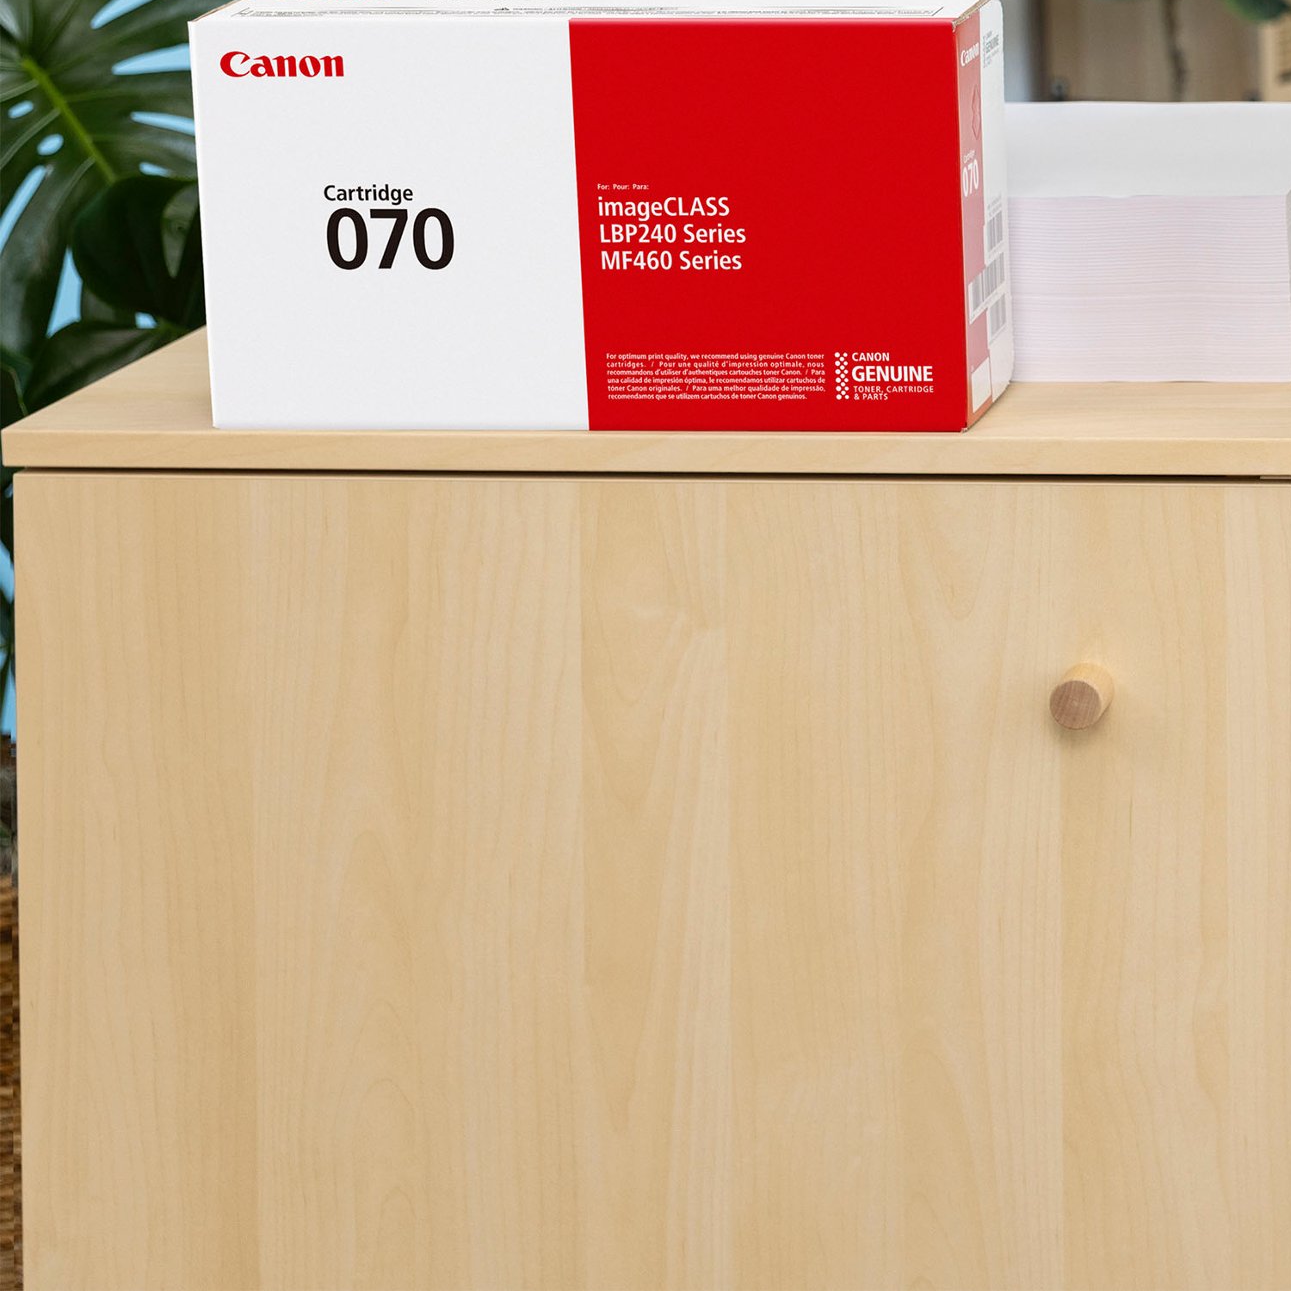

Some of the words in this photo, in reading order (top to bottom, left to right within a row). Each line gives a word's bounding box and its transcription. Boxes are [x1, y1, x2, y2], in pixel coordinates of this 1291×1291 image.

[220, 51, 344, 77] Canon
[960, 42, 980, 66] Canon
[962, 159, 979, 197] 070
[324, 184, 413, 206] Cartridge
[598, 196, 729, 221] imageCLASS
[327, 208, 454, 270] 070
[600, 224, 676, 243] LBP240
[684, 223, 746, 243] Series
[602, 251, 672, 270] MF460
[680, 250, 742, 270] Series
[852, 352, 889, 361] CANON
[852, 366, 933, 382] GENUINE
[854, 386, 883, 394] TONER,
[885, 386, 933, 394] CARTRIDGE
